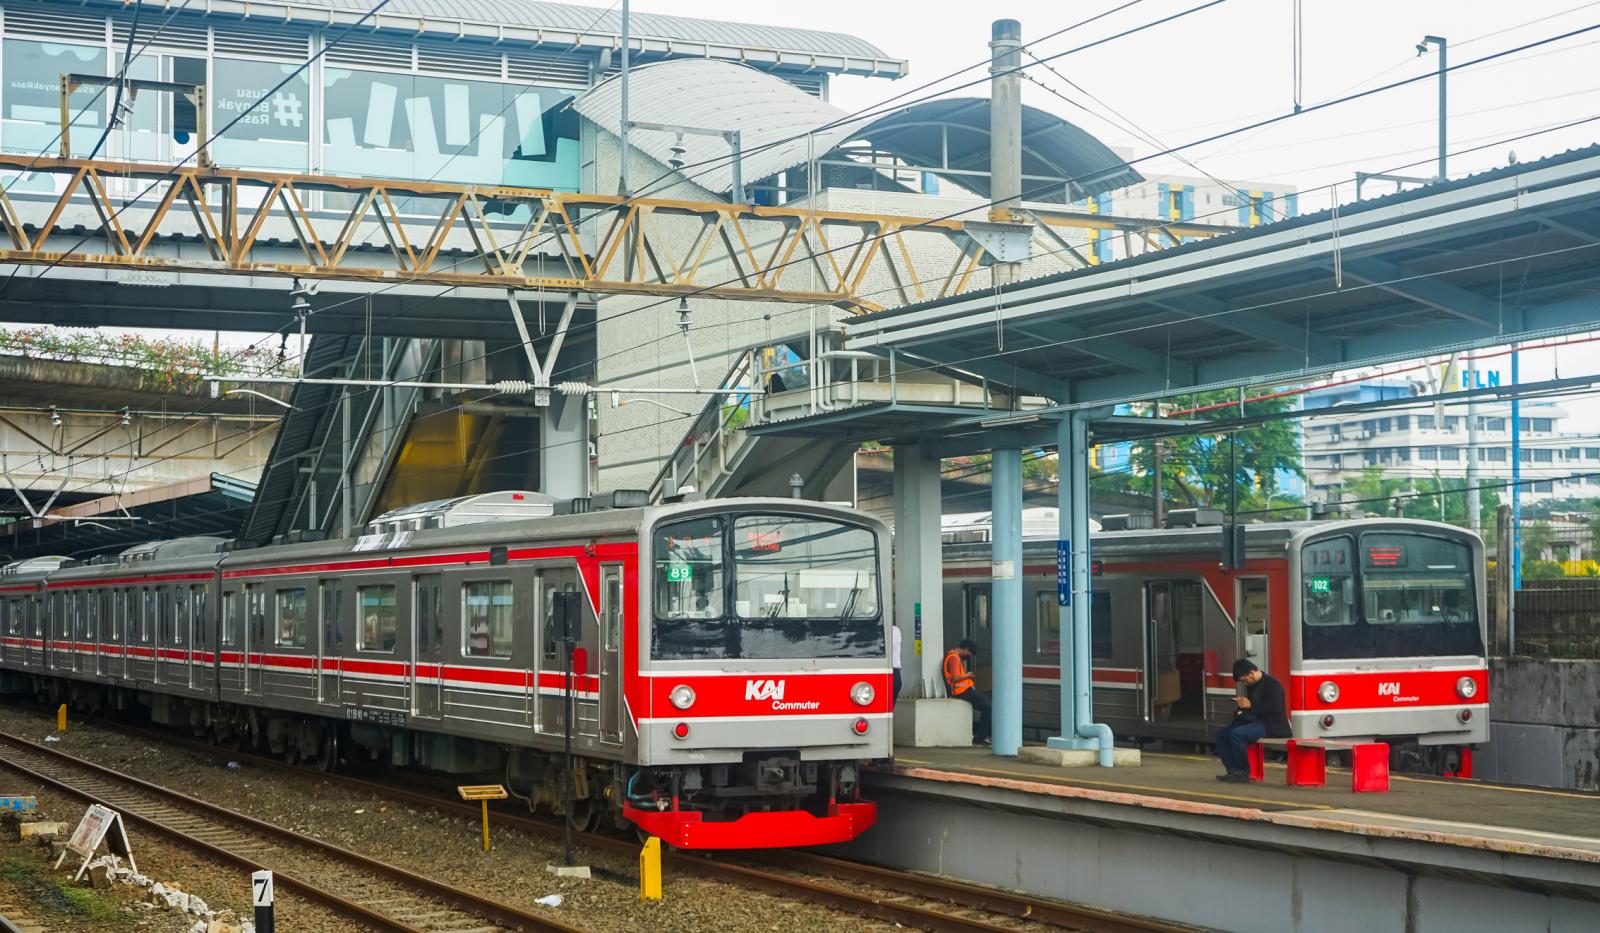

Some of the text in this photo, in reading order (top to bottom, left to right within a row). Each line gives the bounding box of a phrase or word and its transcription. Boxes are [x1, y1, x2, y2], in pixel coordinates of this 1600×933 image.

[671, 567, 689, 578] 89
[1313, 580, 1327, 590] 102
[745, 680, 785, 701] KAI
[1378, 682, 1400, 695] KAI
[771, 700, 820, 710] Commuter
[254, 879, 269, 902] 7
